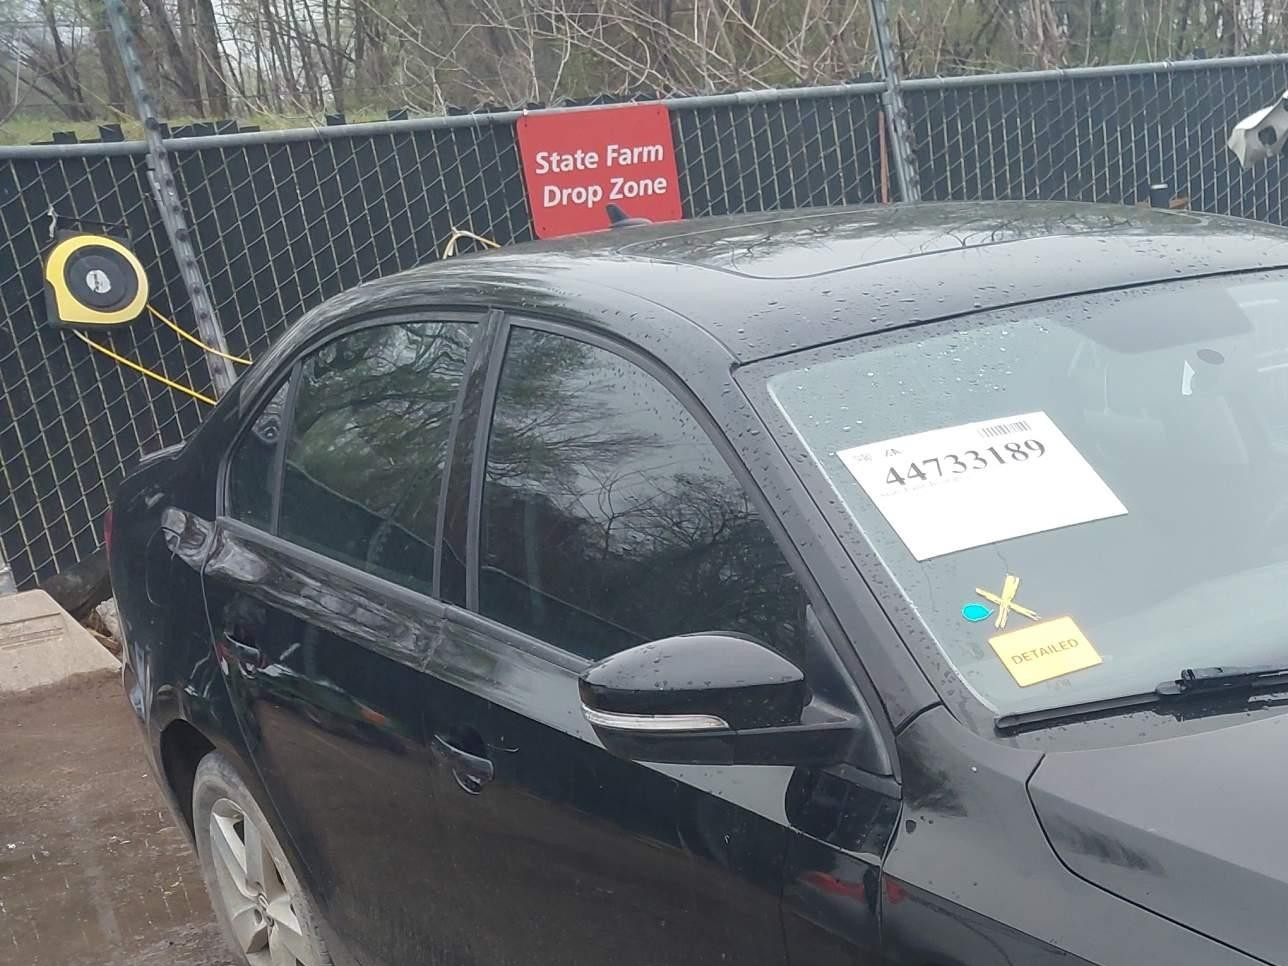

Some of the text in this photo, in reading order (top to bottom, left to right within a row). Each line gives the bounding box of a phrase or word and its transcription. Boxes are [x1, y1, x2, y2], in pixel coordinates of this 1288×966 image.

[535, 144, 664, 174] State Farm
[543, 177, 667, 208] Drop Zone
[885, 439, 1046, 486] 44733189
[1011, 638, 1079, 665] DETAILED
